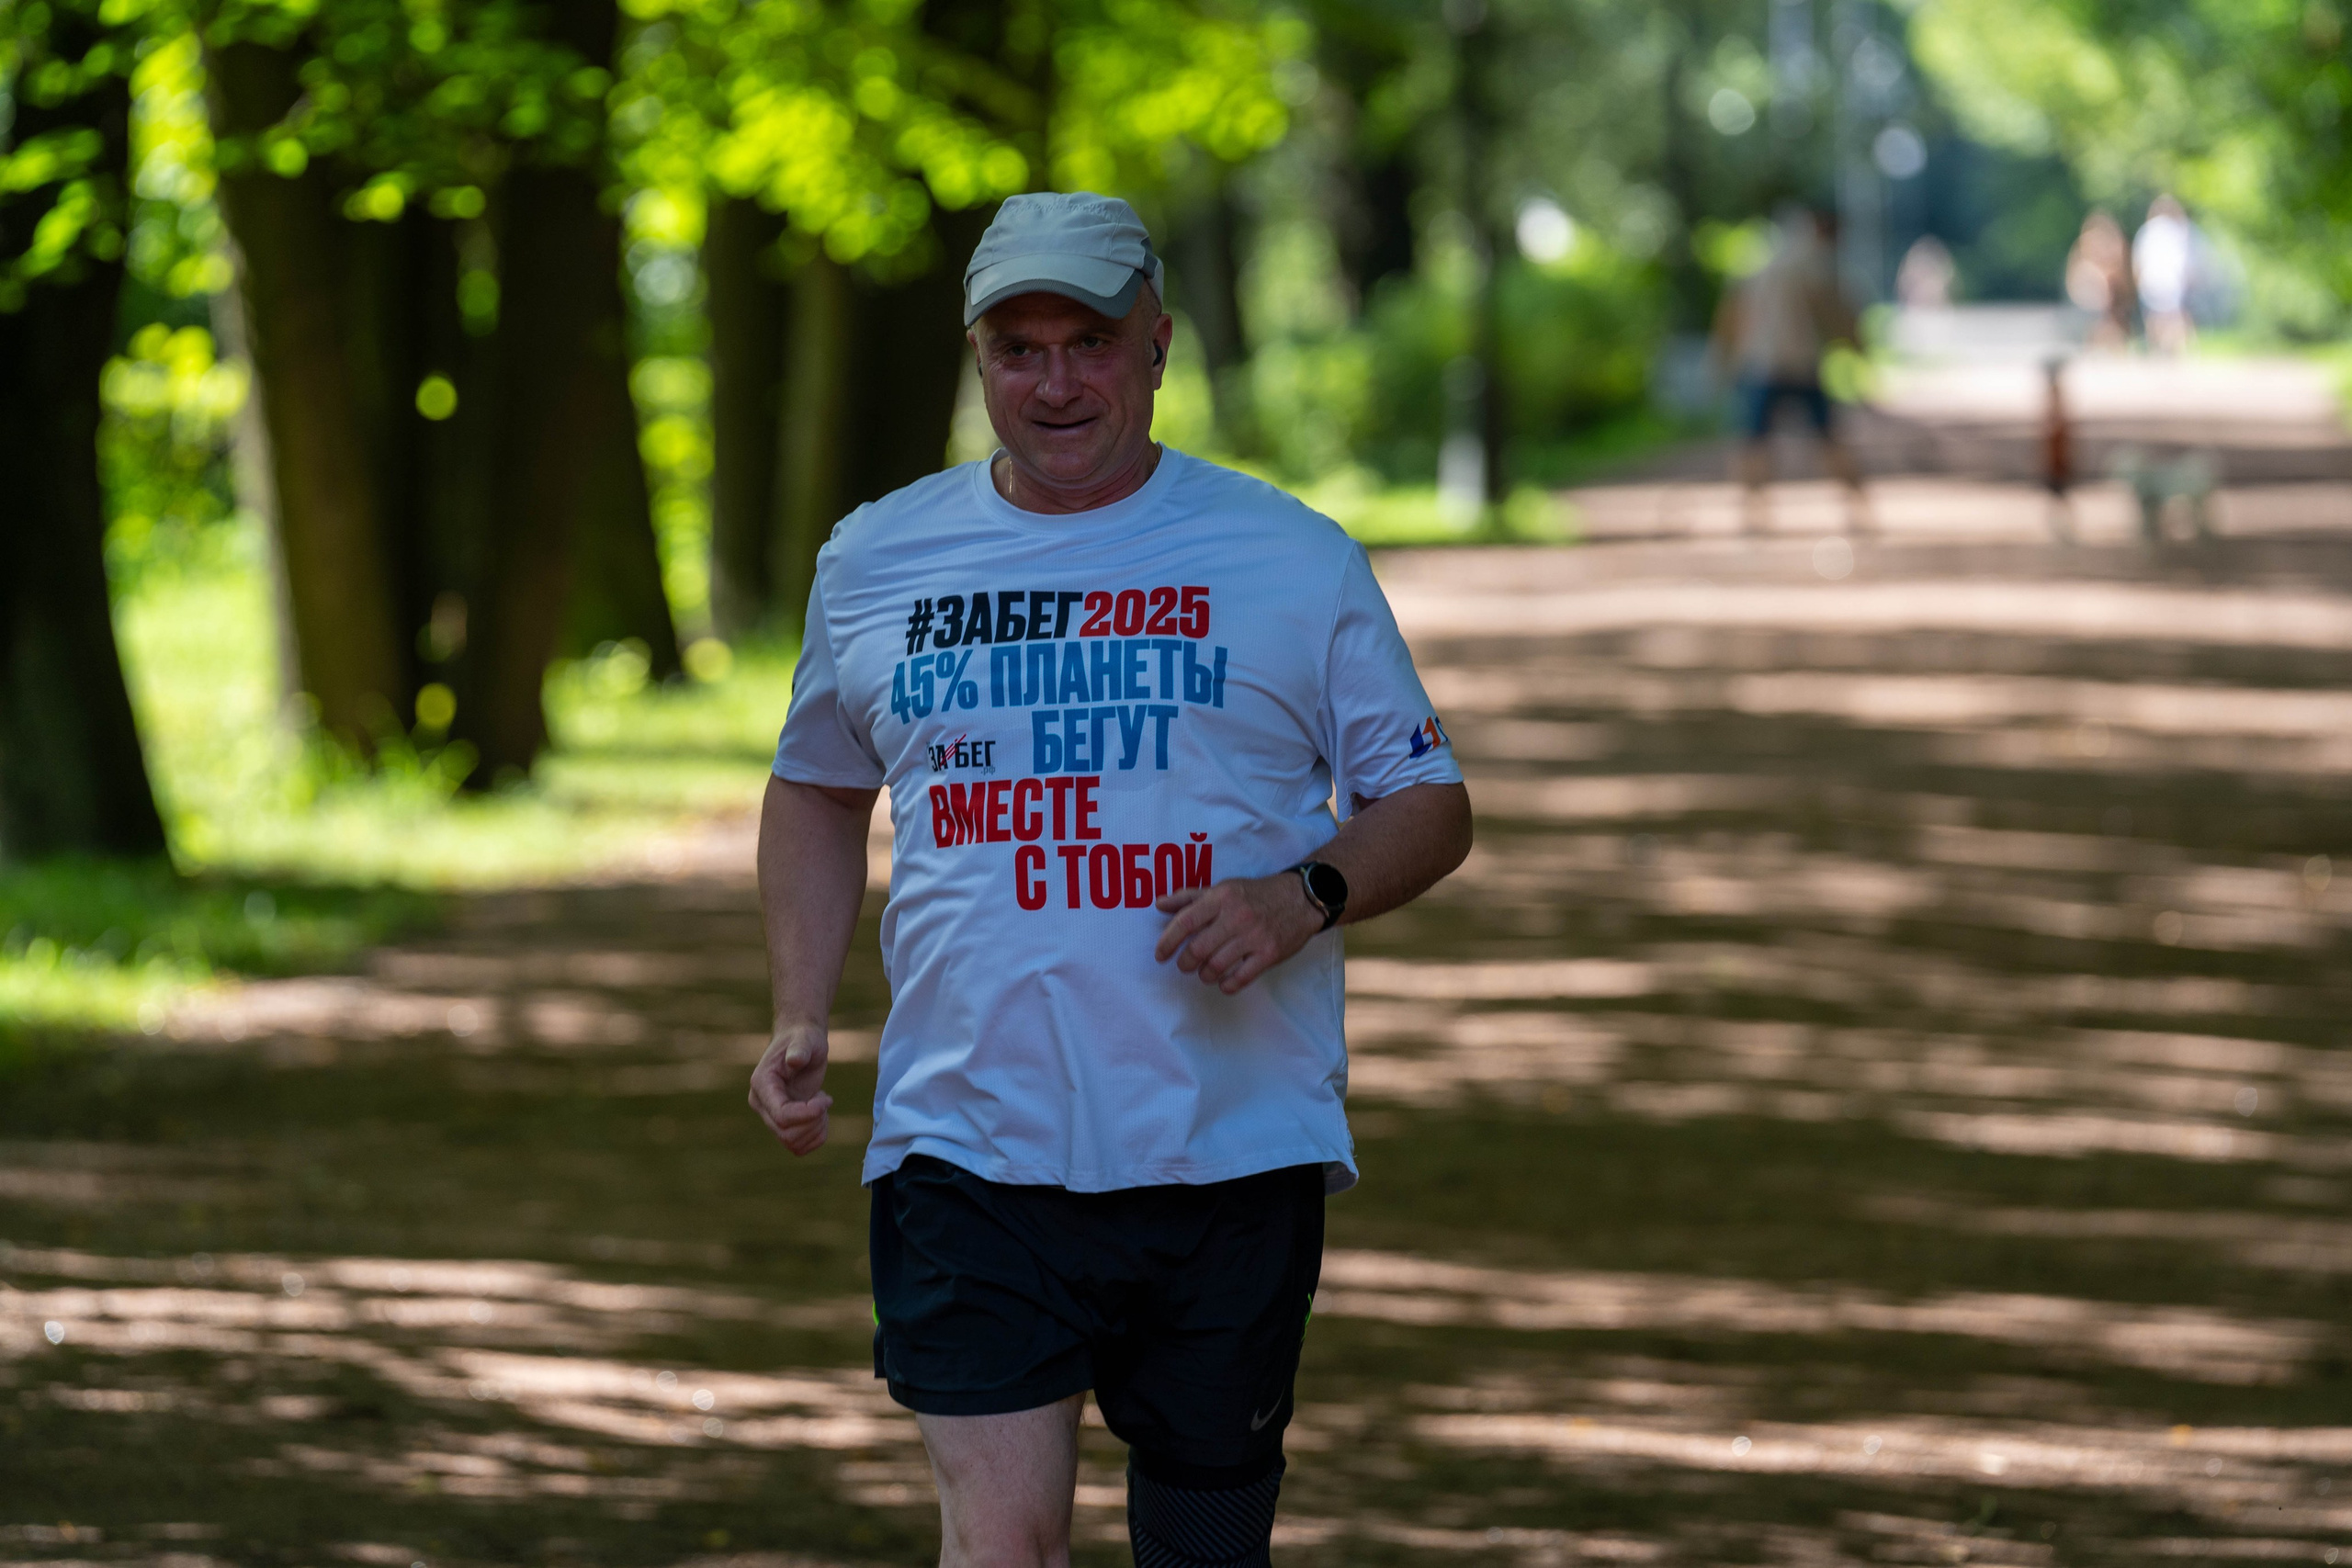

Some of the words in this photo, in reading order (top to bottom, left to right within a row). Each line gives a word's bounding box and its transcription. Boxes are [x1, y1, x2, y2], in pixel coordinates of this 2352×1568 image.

[906, 586, 1210, 656] #ЗАБЕГ2025
[890, 649, 978, 725] 45%
[990, 638, 1227, 708] ПЛАНЕТЫ
[1032, 705, 1179, 774] БЕГУТ
[929, 775, 1102, 849] ВМЕСТЕ
[1014, 844, 1046, 910] С
[1057, 832, 1213, 909] ТОБОЙ
